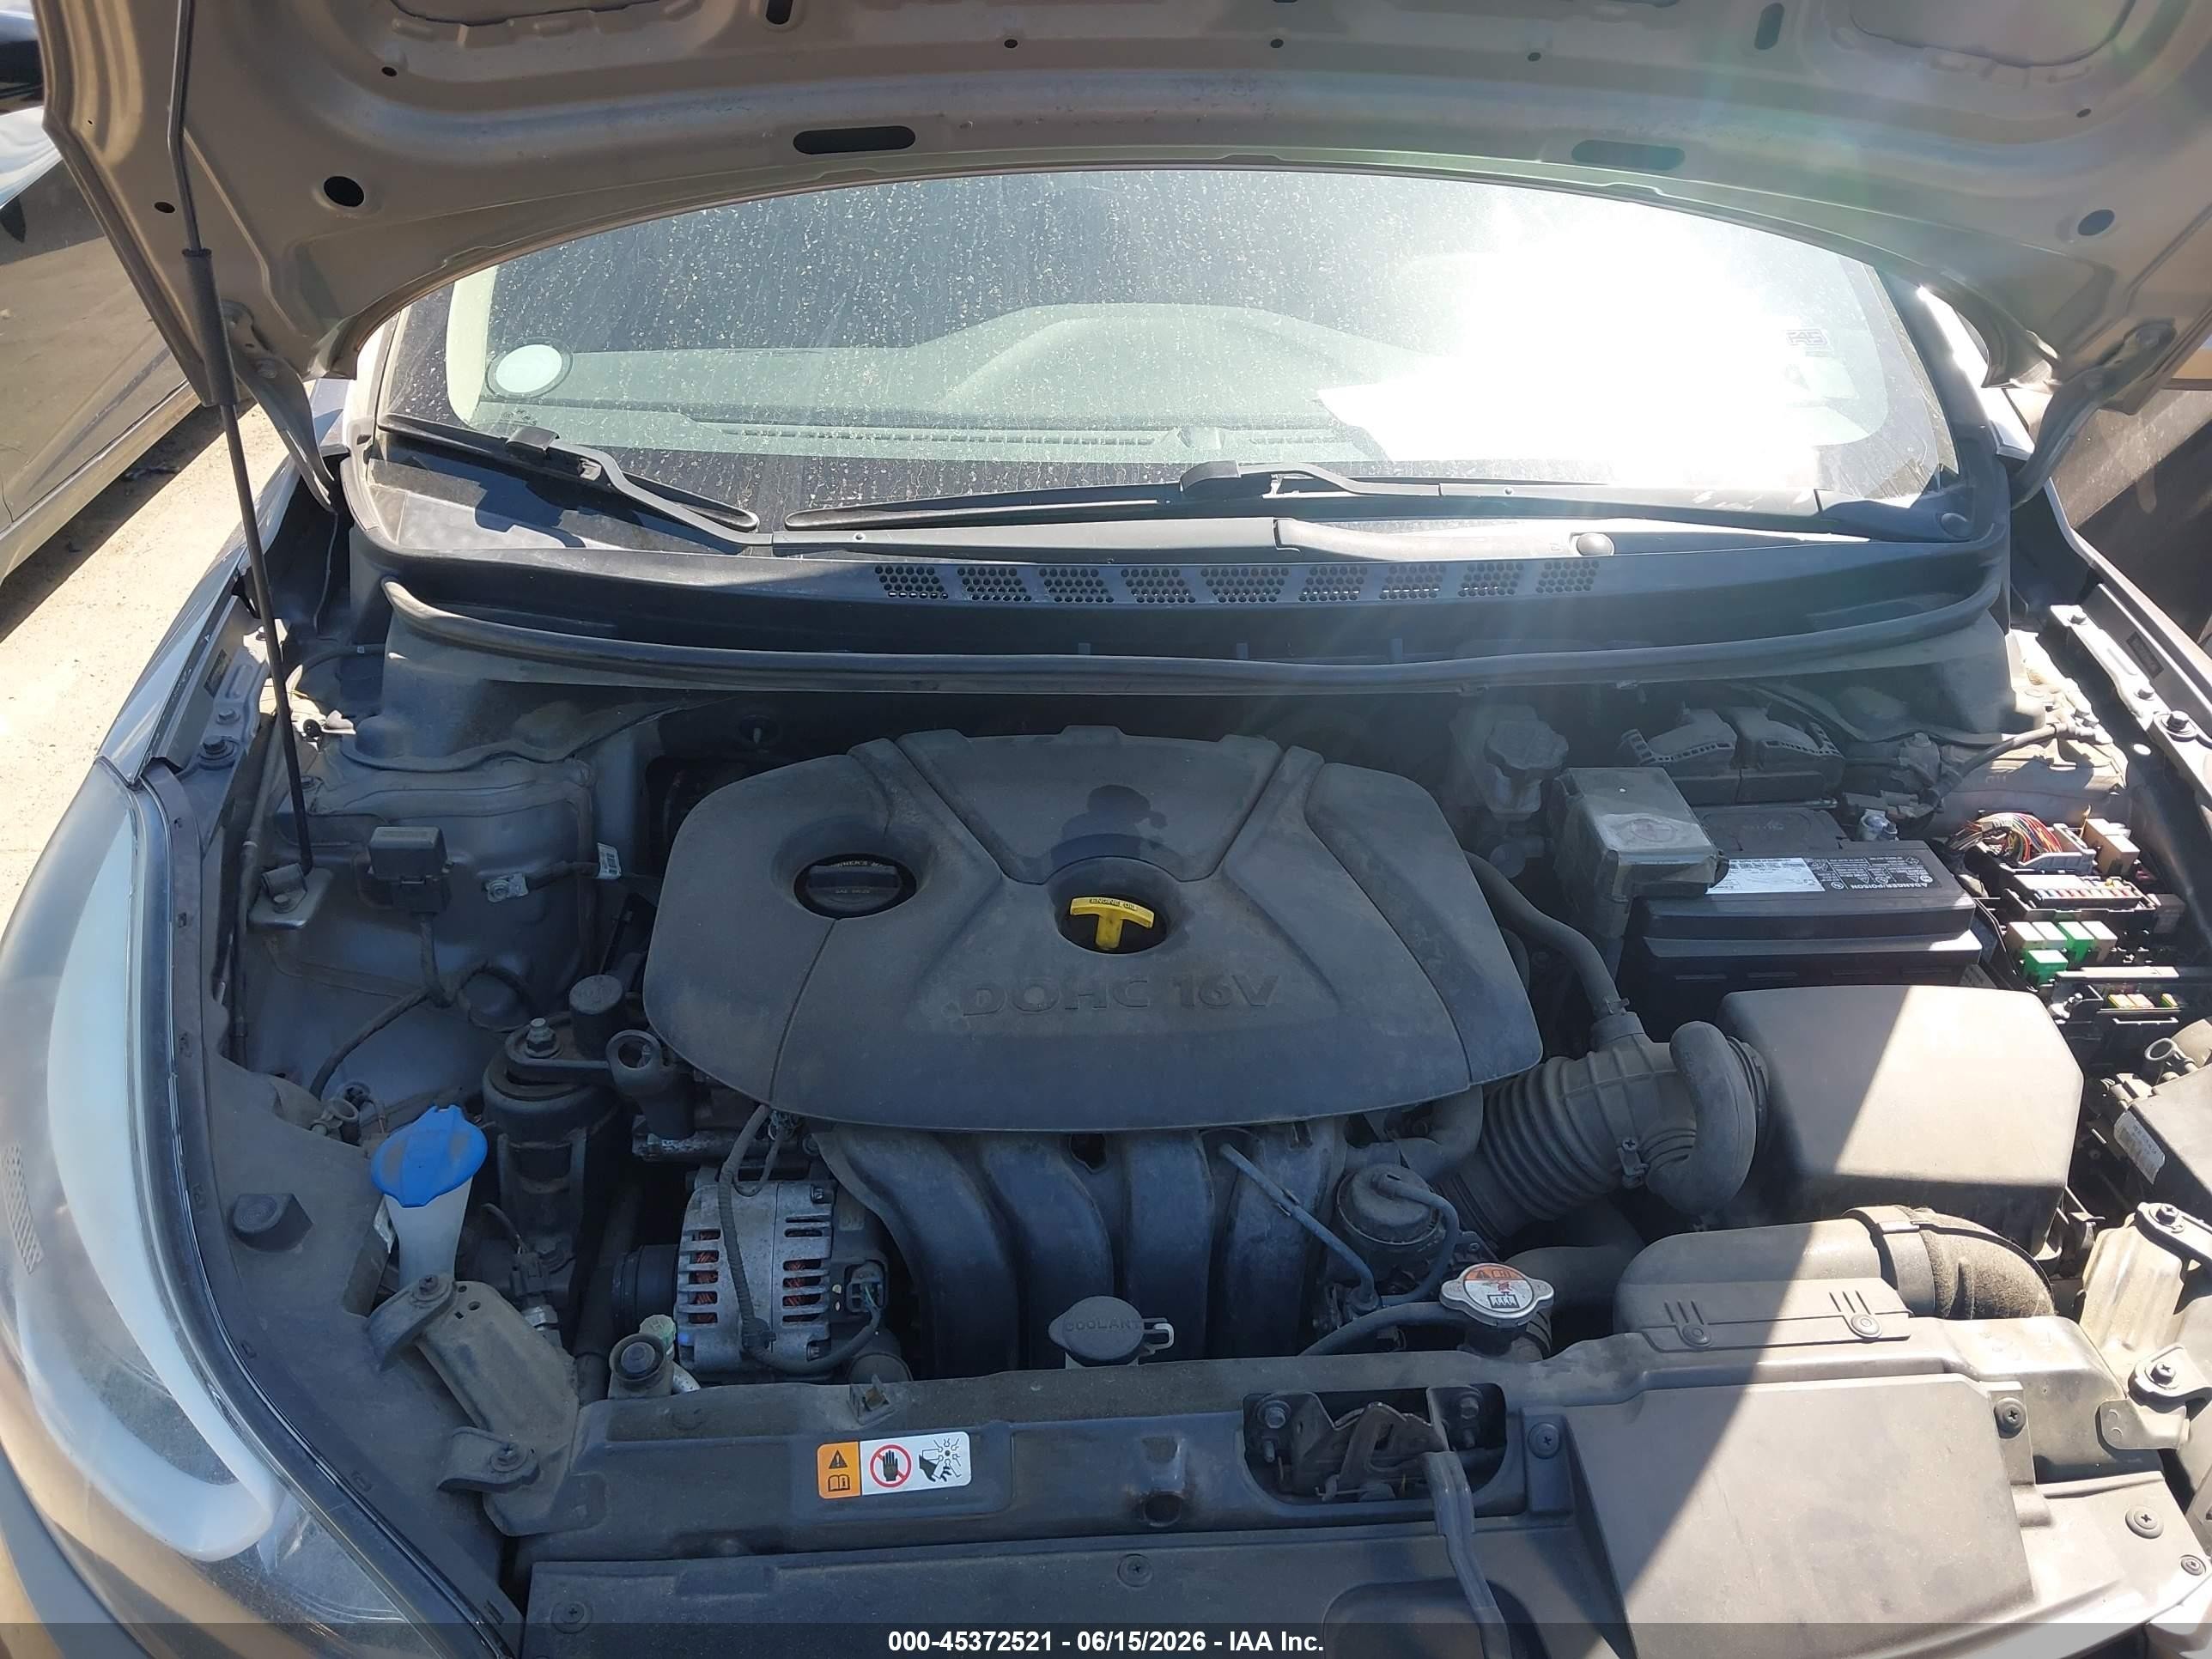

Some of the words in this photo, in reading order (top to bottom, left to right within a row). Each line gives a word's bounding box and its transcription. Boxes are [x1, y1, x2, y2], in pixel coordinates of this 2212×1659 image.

[1091, 898, 1120, 907] ENGINE
[963, 980, 1148, 1017] DOHC
[1169, 975, 1281, 1008] 16V
[1065, 1318, 1141, 1332] COOLANT
